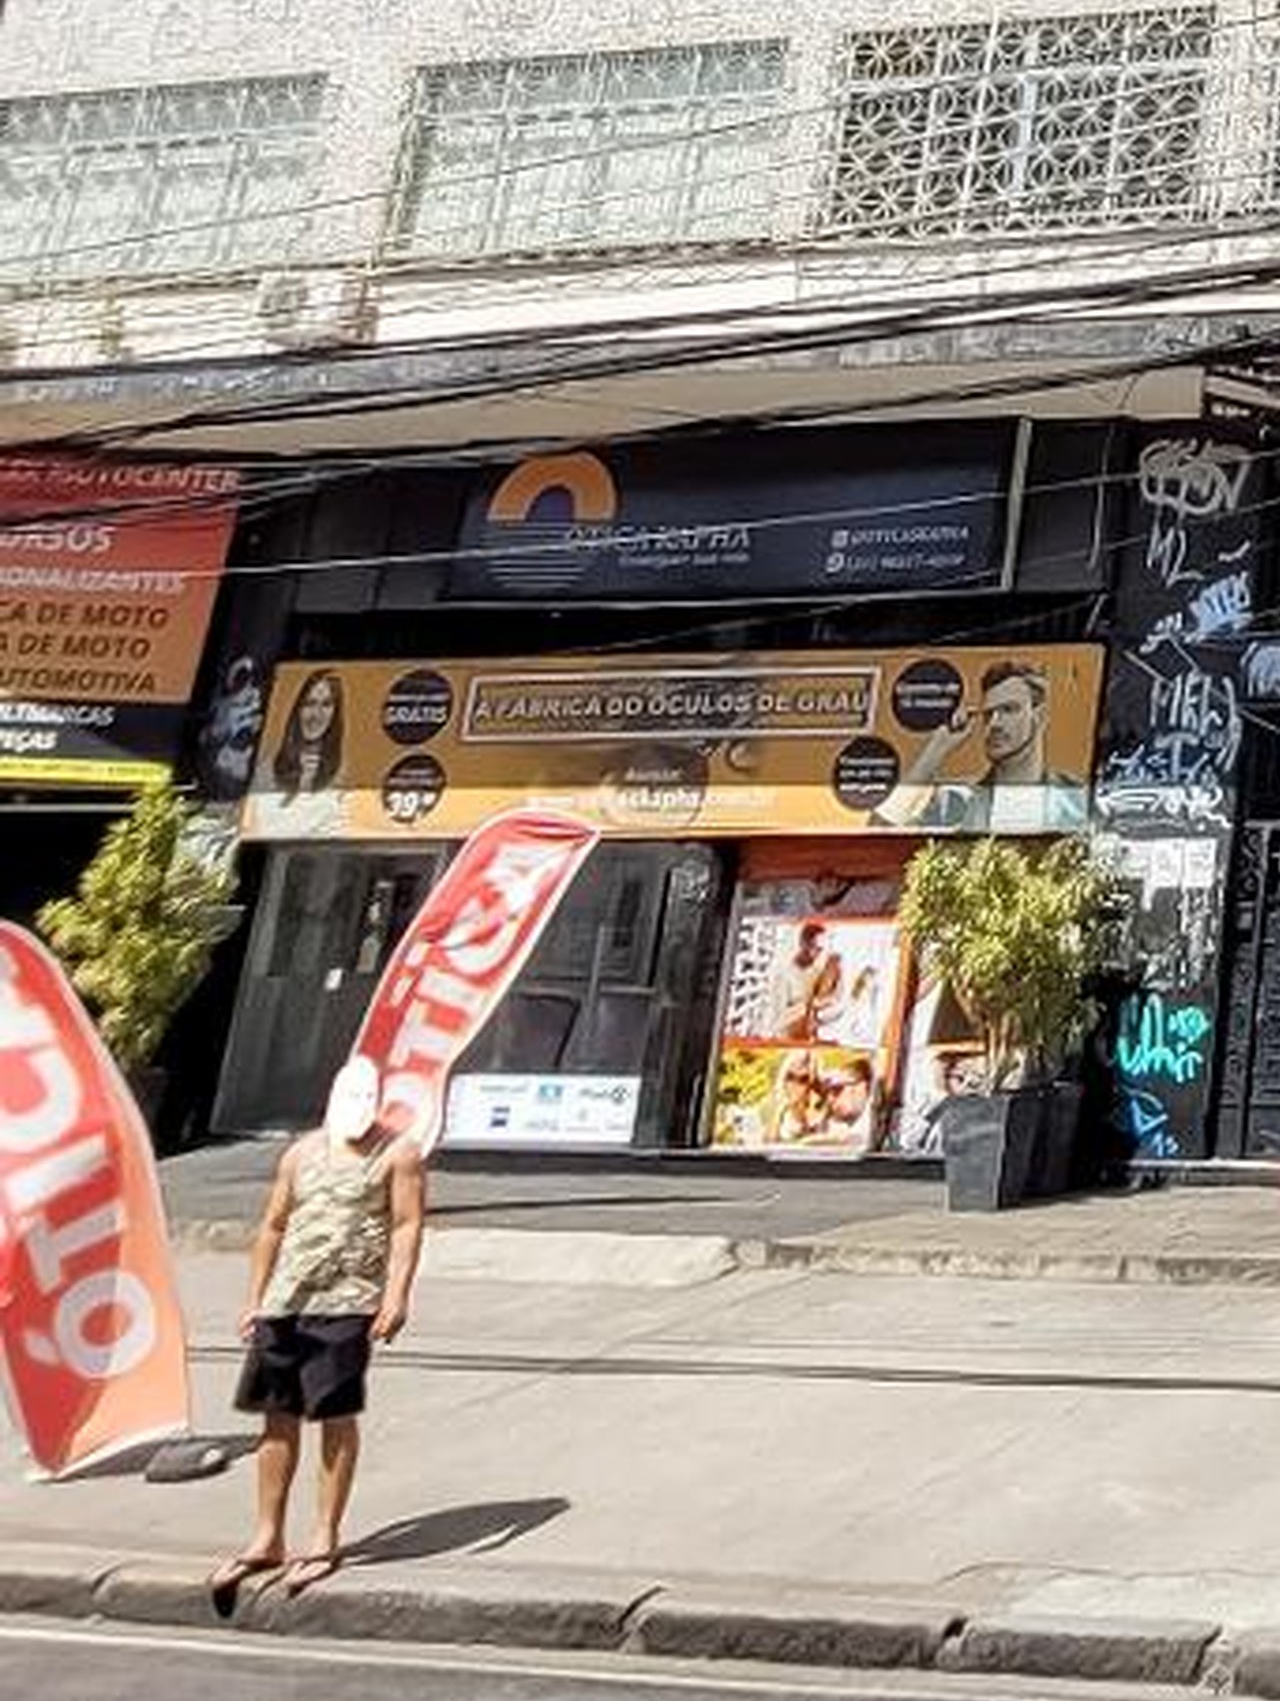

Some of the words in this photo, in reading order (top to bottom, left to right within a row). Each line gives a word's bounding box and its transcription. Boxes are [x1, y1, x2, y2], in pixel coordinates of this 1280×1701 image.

[36, 603, 74, 626] DE
[81, 603, 170, 629] MOTO
[18, 632, 57, 657] DE
[61, 634, 151, 660] MOTO
[0, 667, 155, 693] UTOMOTIVA
